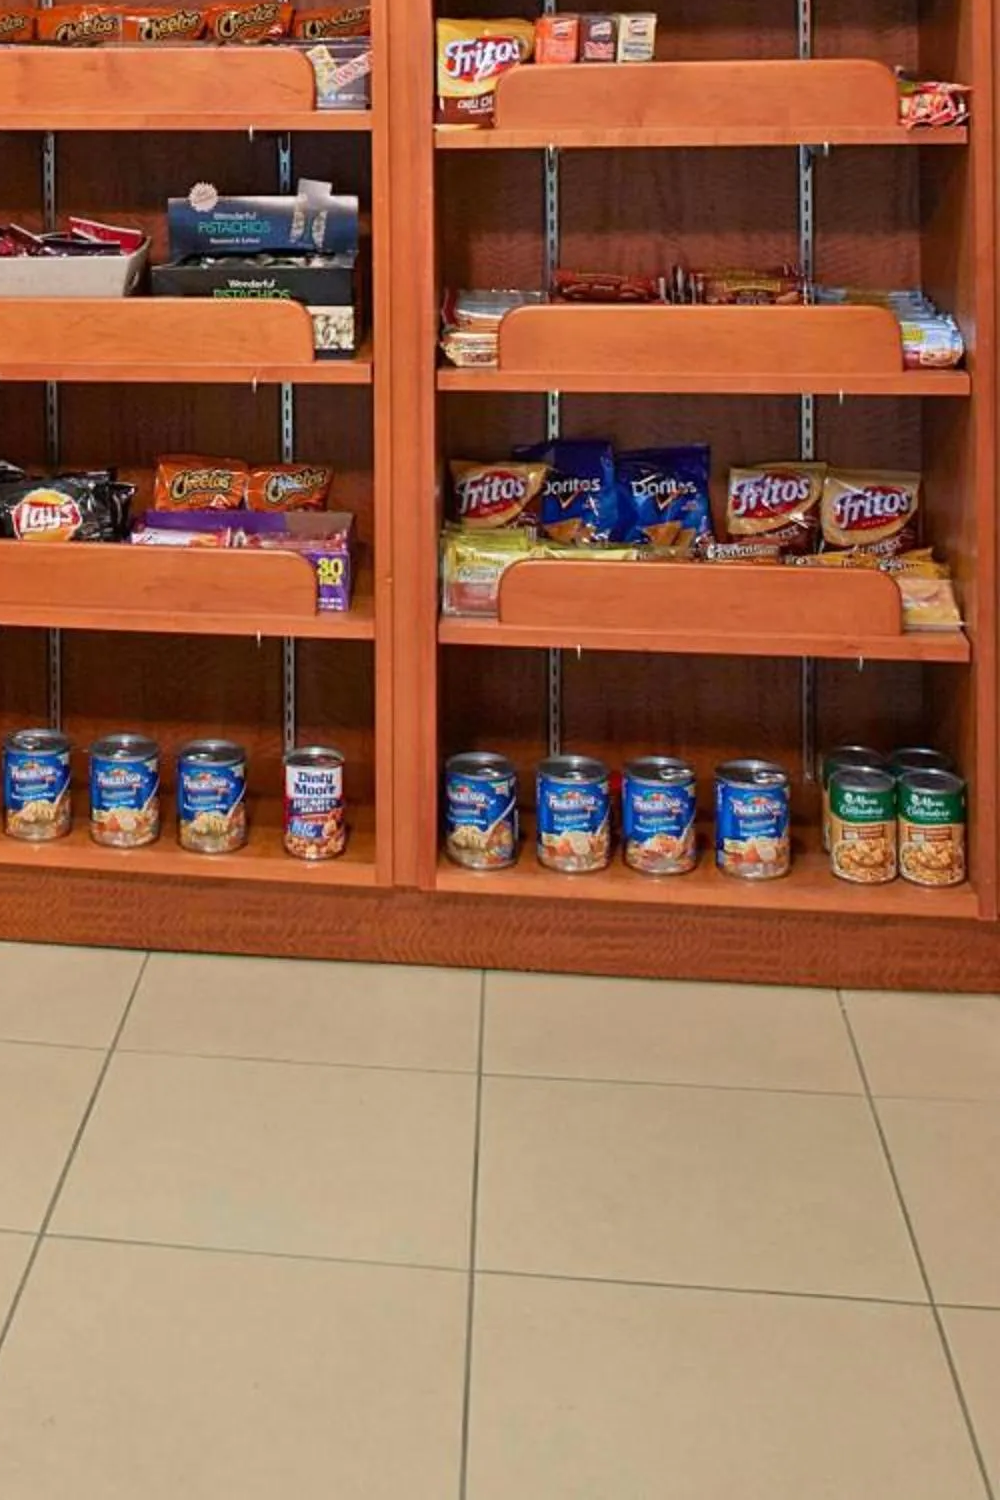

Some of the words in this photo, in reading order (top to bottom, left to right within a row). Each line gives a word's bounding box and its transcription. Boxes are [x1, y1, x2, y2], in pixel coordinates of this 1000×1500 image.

[56, 17, 118, 42] Cheetos
[141, 10, 201, 41] Cheetos
[216, 4, 280, 40] Cheetos
[445, 36, 521, 80] Fritos
[199, 221, 270, 233] PISTACHIOS
[228, 279, 276, 289] Wonderful
[171, 469, 233, 500] Cheetos
[456, 475, 525, 512] Fritos
[631, 479, 697, 497] Doritos
[732, 476, 811, 515] Fritos
[834, 491, 910, 528] Fritos
[294, 783, 336, 797] Moore
[298, 772, 333, 785] Dinty
